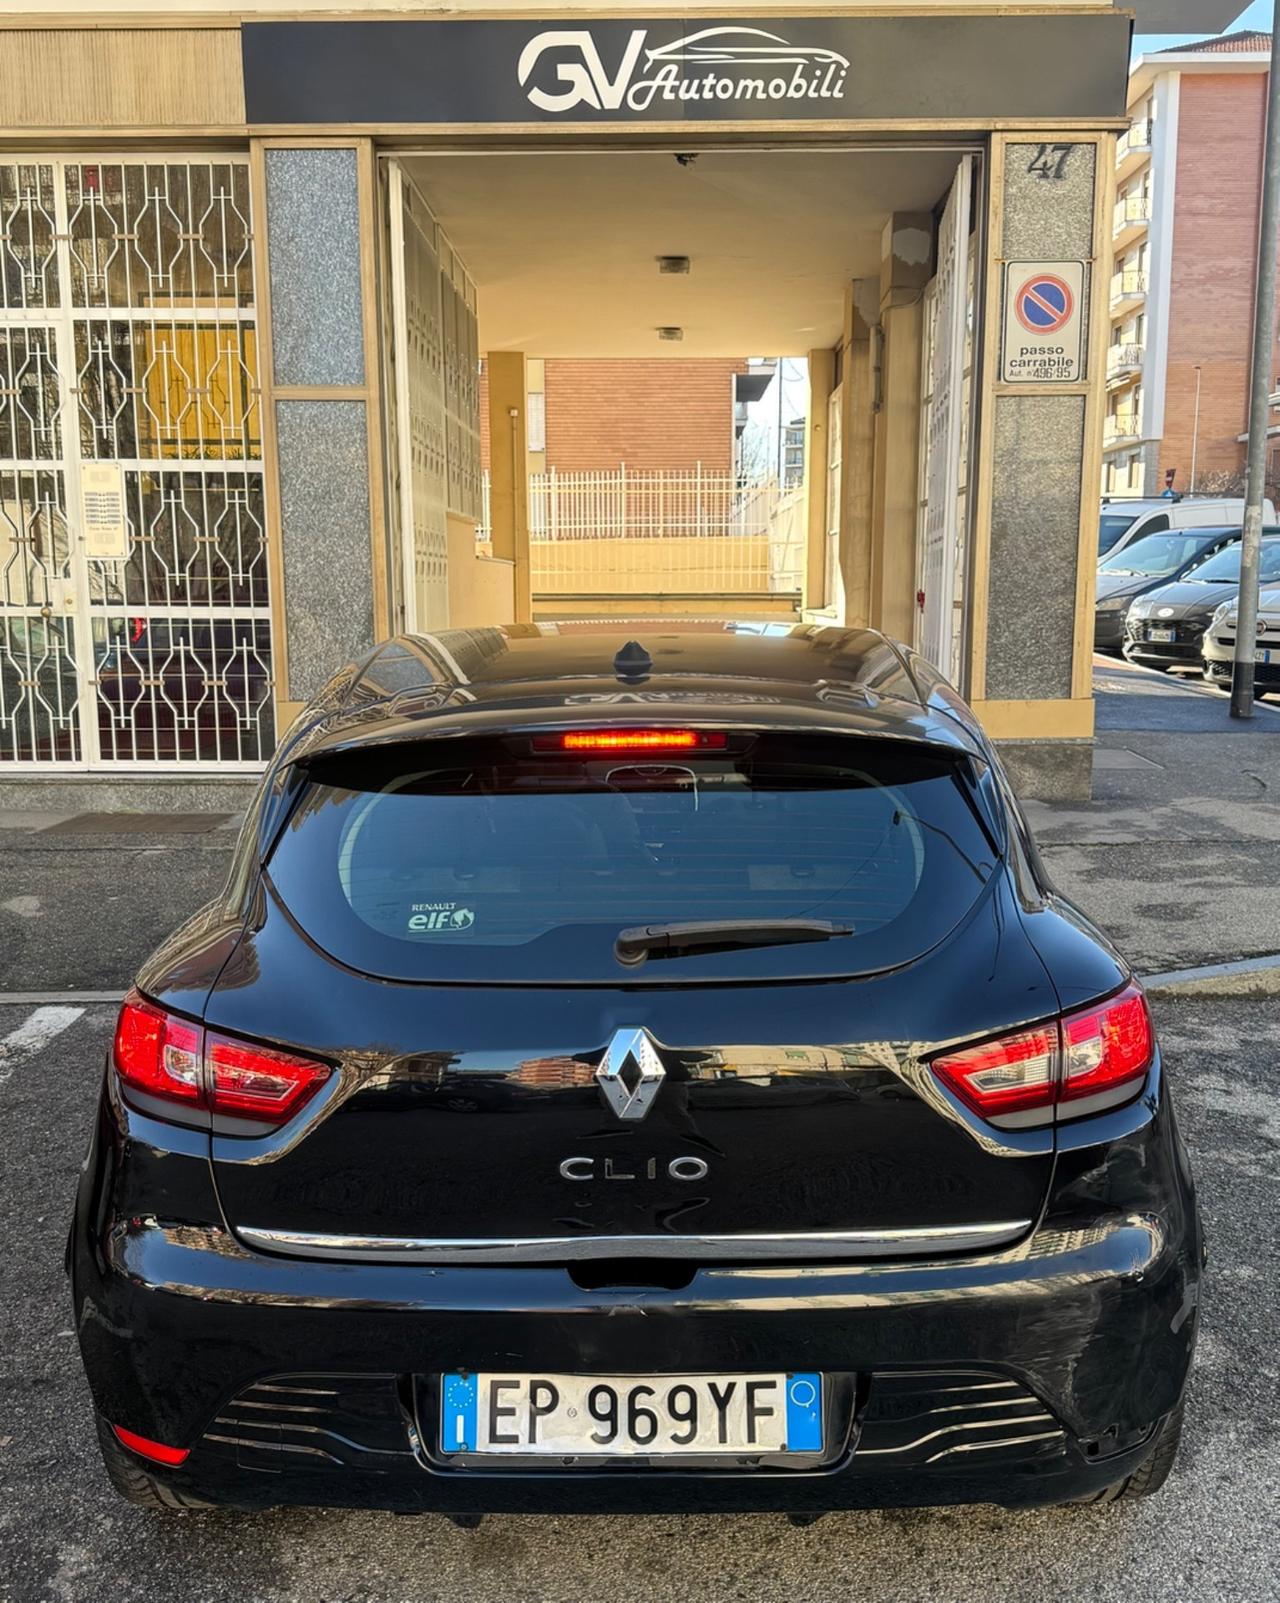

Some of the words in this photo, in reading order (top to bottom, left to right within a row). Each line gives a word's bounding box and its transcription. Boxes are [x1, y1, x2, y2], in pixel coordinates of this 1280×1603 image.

[517, 30, 648, 112] GV
[626, 63, 848, 112] Automobili
[1028, 143, 1075, 179] 47
[1009, 356, 1074, 368] carrabile
[1020, 346, 1064, 358] passo
[411, 902, 456, 911] RENAULT
[408, 911, 450, 930] elf
[559, 1156, 708, 1181] CLIO
[488, 1379, 560, 1444] EP
[588, 1379, 778, 1445] 969YF
